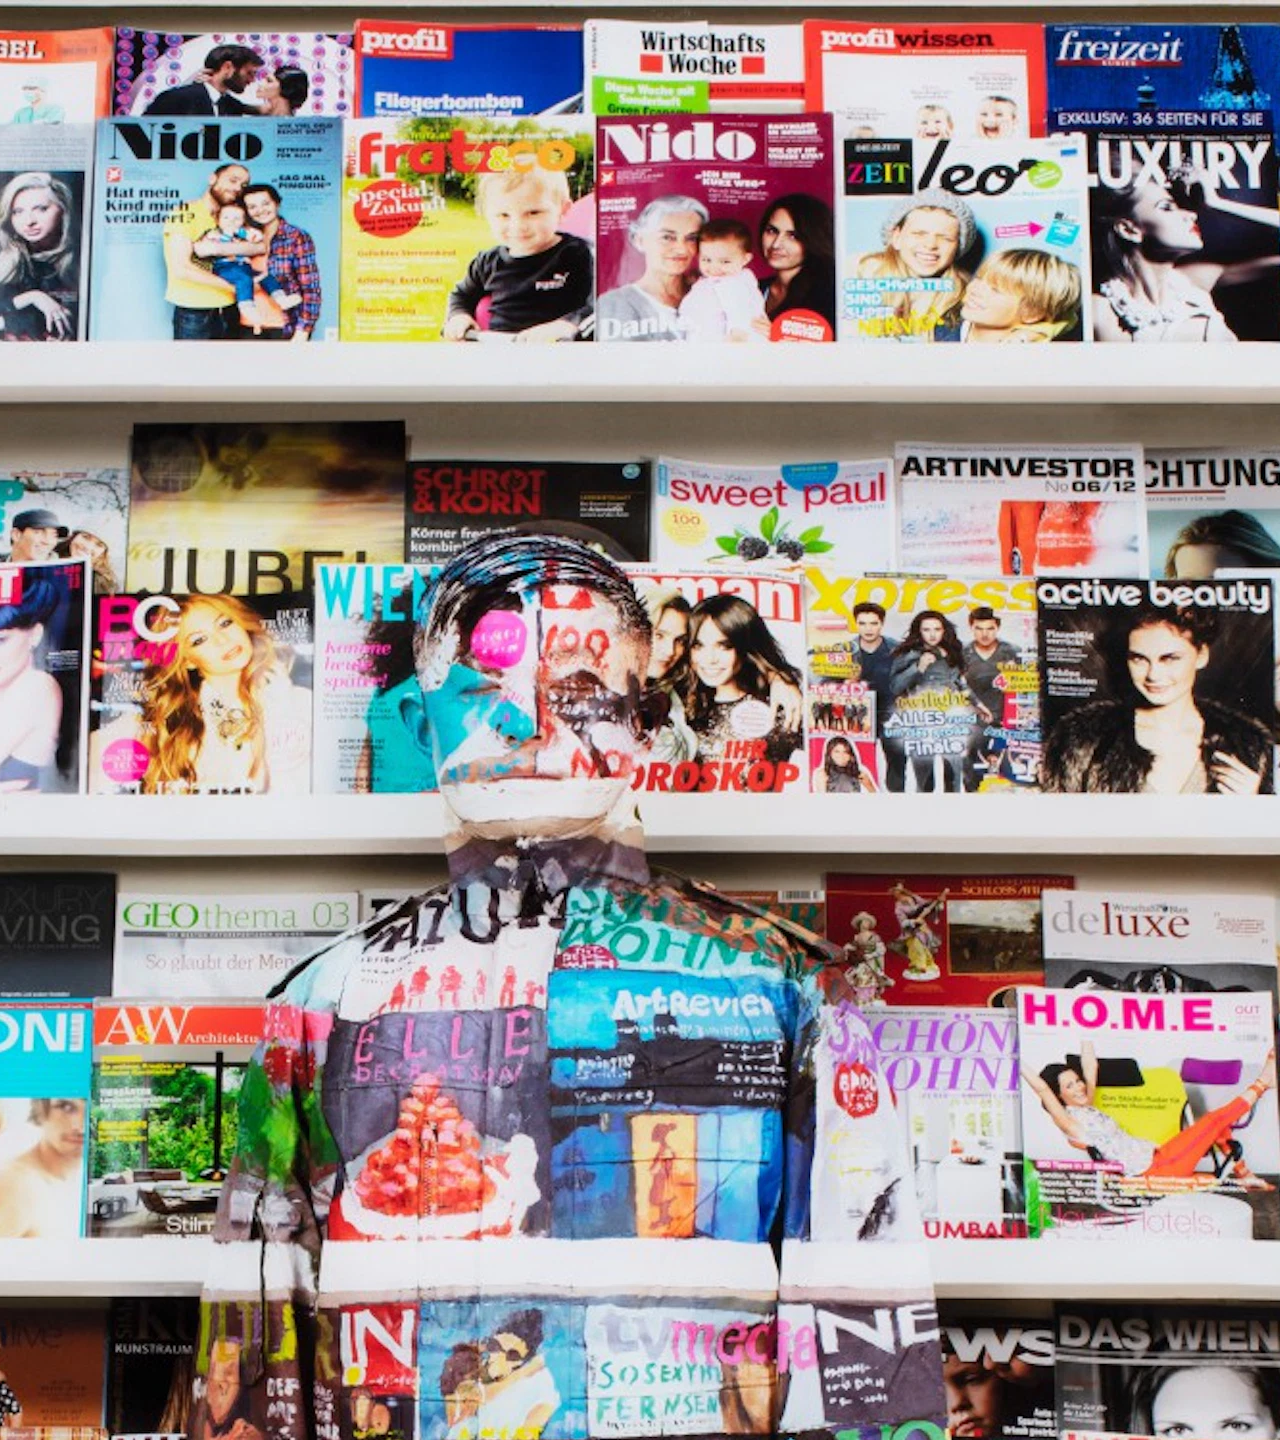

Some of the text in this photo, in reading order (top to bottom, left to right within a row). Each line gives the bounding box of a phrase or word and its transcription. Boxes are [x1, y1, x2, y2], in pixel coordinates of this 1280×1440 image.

[362, 31, 448, 54] profil
[641, 33, 766, 56] Wirtschafts
[1058, 33, 1182, 62] freizeit
[669, 55, 738, 76] Woche
[375, 94, 525, 111] Fliegerbomben
[1058, 112, 1264, 127] EXKLUSIV: 36 SEITEN FÜR SIE
[111, 125, 264, 162] Nido
[600, 124, 757, 164] Nido
[847, 162, 912, 186] ZEIT
[106, 188, 181, 200] Hat mein
[106, 201, 191, 214] Kind mich
[105, 213, 196, 225] verändert?
[902, 459, 1136, 478] ARTINVESTOR
[413, 470, 547, 492] SCHROT
[1072, 481, 1137, 493] 06/12
[412, 492, 540, 516] & KORN
[670, 474, 887, 512] sweet paul
[411, 528, 457, 540] Körner
[1039, 585, 1270, 614] active beauty
[889, 712, 946, 726] ALLES
[313, 904, 351, 928] 03
[1053, 902, 1191, 937] deluxe
[1024, 993, 1228, 1030] H.O.M.E.
[115, 1344, 193, 1353] KUNSTRAUM
